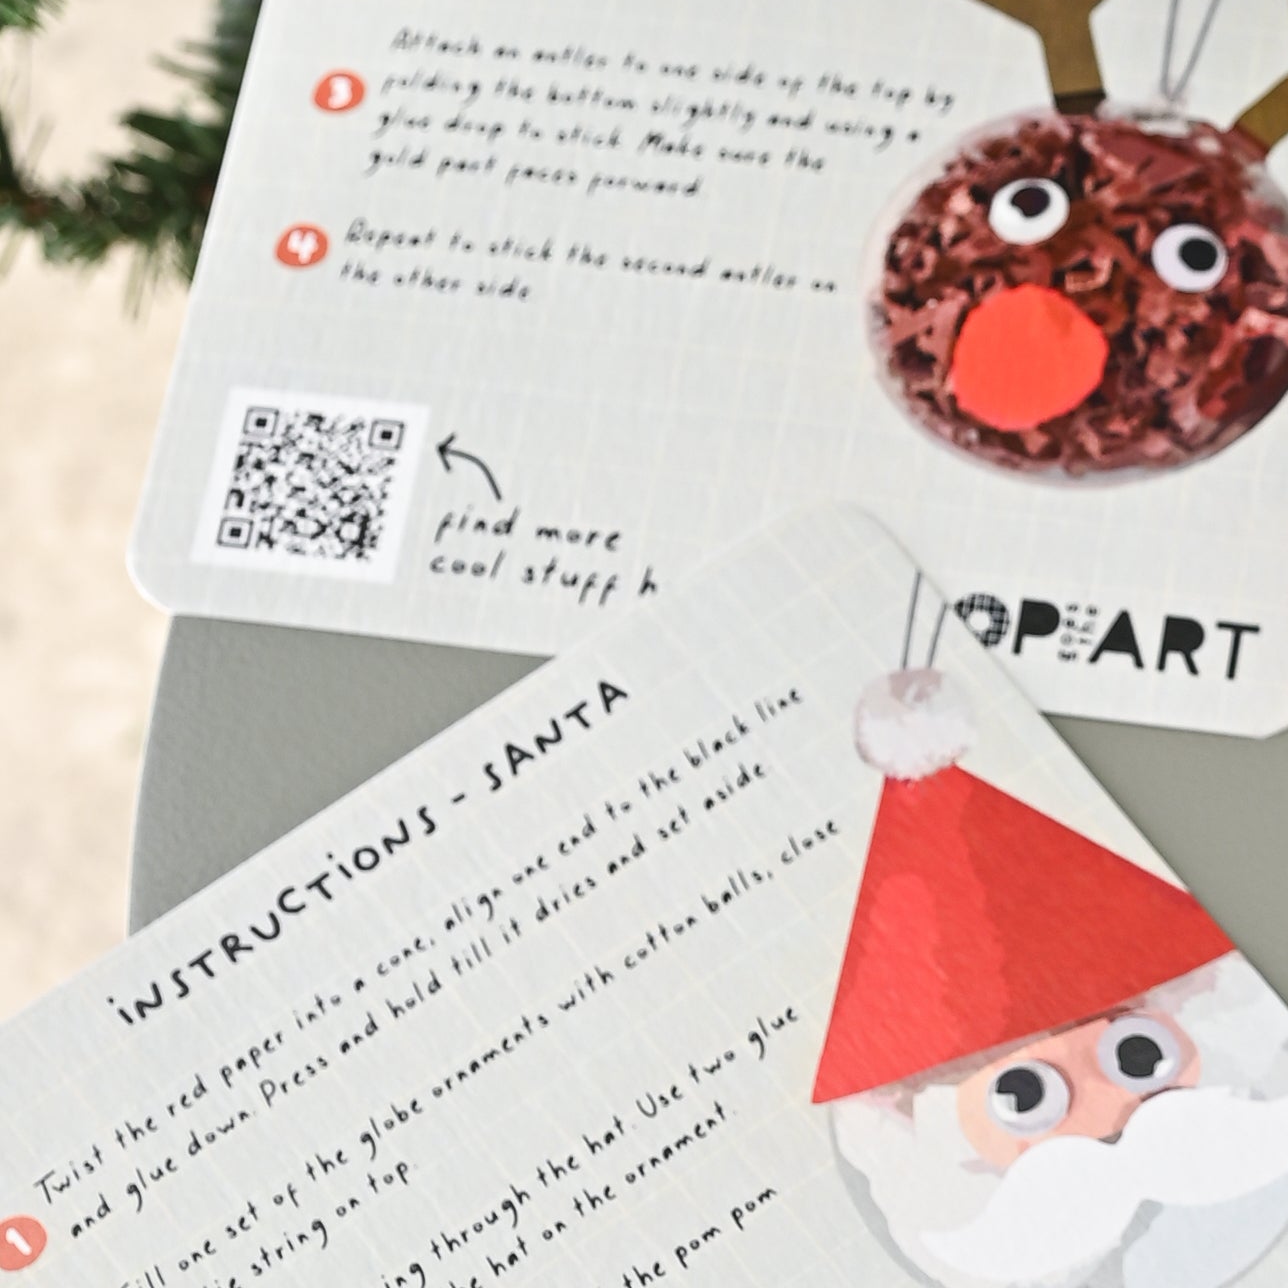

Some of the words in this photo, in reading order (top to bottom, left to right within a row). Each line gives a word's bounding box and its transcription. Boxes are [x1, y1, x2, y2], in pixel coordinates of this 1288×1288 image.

[288, 230, 316, 261] 4
[433, 504, 520, 544] find
[534, 525, 622, 552] more
[428, 549, 506, 579] cool
[520, 556, 618, 607] stuff
[953, 593, 1060, 654] OP
[1088, 609, 1260, 679] ART
[482, 679, 628, 792] SANTA
[6, 1228, 31, 1254] 1
[32, 1143, 103, 1204] Twist
[114, 1115, 158, 1149] the
[166, 1072, 208, 1117] red
[218, 1030, 283, 1089] paper
[292, 993, 342, 1030] into
[352, 977, 366, 993] a
[443, 887, 503, 932] align
[511, 854, 549, 885] one
[557, 813, 597, 856] end
[604, 801, 632, 821] to
[638, 766, 681, 798] the
[682, 714, 749, 769] black
[753, 687, 802, 722] line
[70, 1192, 111, 1239] and
[125, 1156, 178, 1214] glue
[258, 1055, 328, 1108] Press
[338, 1010, 379, 1055] and
[384, 968, 442, 1019] hold
[450, 936, 492, 976] till
[499, 917, 521, 944] it
[535, 875, 597, 922] dries
[606, 833, 647, 875] and
[656, 805, 689, 841] set
[702, 762, 766, 811] aside
[177, 1238, 216, 1272] one
[224, 1200, 258, 1239] set
[272, 1182, 299, 1208] of
[305, 1148, 348, 1181] the
[359, 1097, 423, 1162] globe
[431, 1013, 549, 1098] ornaments
[557, 965, 615, 1011] with
[623, 915, 698, 969] cotton
[780, 819, 839, 865] close
[430, 1183, 531, 1261] through
[535, 1154, 580, 1188] the
[635, 1084, 683, 1118] Use
[687, 1050, 736, 1084] two
[747, 1005, 798, 1061] glue
[250, 1218, 328, 1276] string
[335, 1197, 360, 1217] on
[485, 1234, 528, 1277] hat
[541, 1220, 567, 1241] on
[572, 1184, 616, 1217] the
[673, 1226, 721, 1269] pom
[729, 1187, 777, 1231] pom
